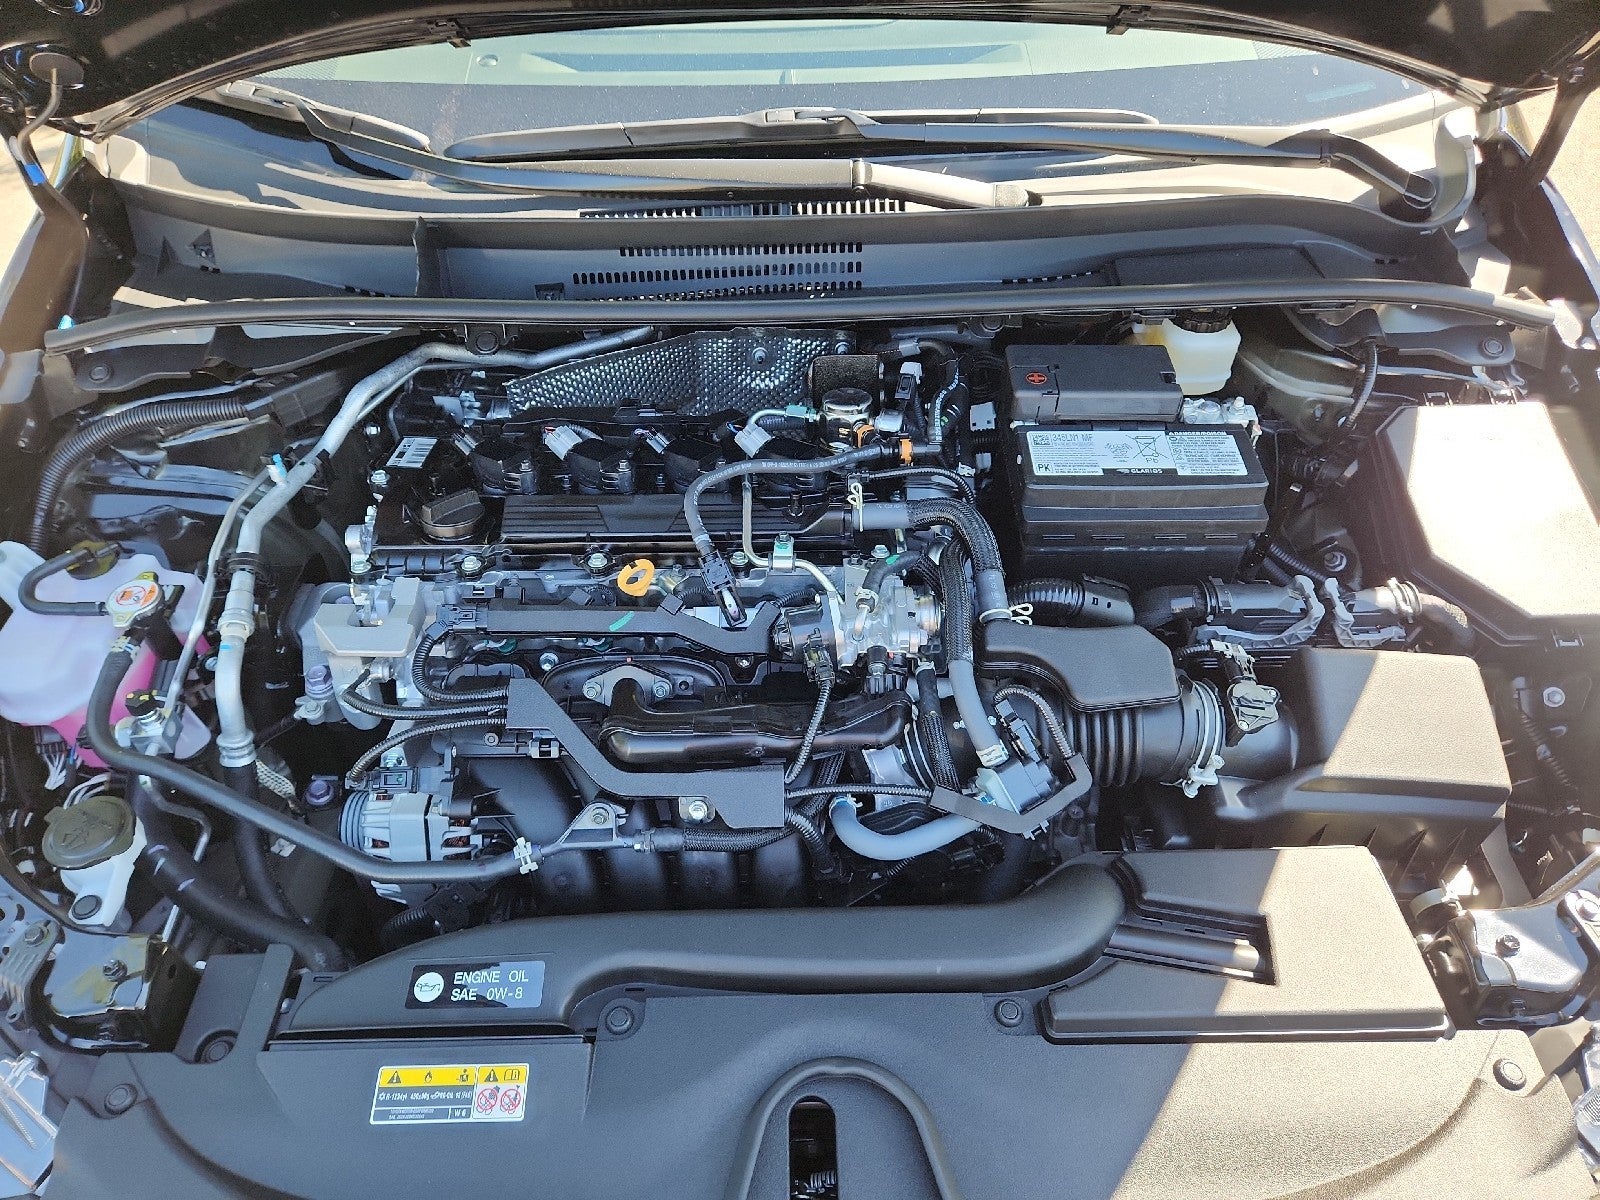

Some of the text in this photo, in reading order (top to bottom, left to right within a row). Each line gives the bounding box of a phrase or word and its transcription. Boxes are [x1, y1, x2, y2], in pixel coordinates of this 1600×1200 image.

[1037, 463, 1051, 472] PK
[454, 970, 529, 985] ENGINE OIL
[451, 987, 523, 1002] SAE 0W-8
